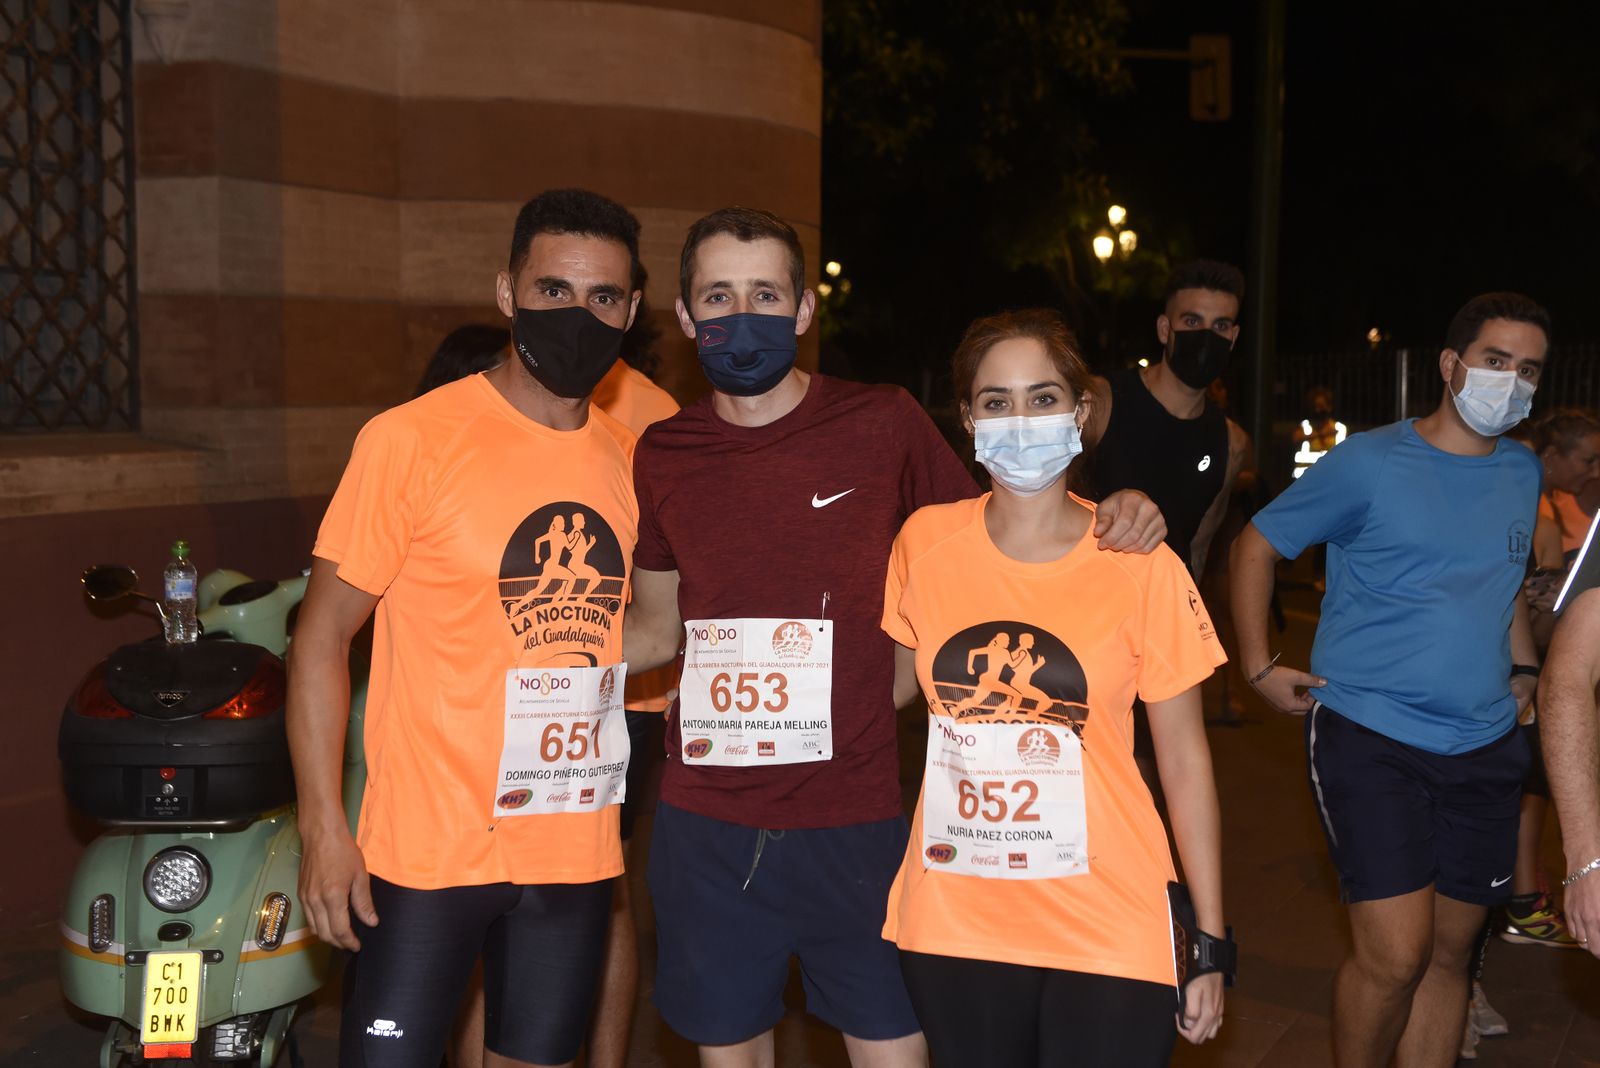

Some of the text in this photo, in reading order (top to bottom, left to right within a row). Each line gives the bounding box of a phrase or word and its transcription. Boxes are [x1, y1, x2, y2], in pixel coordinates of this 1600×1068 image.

[511, 616, 532, 636] LA
[523, 625, 605, 650] del Guadalquivir
[709, 672, 789, 713] 653
[526, 711, 551, 719] CARRERA
[682, 719, 828, 730] ANTONIO MARIA PAREJA MELLING
[540, 718, 601, 763] 651
[505, 769, 551, 781] DOMINGO
[588, 761, 625, 777] GUTIERREZ
[958, 778, 1041, 823] 652
[947, 824, 975, 839] NURIA
[976, 828, 1003, 842] PAEZ
[1005, 829, 1054, 842] CORONA
[162, 962, 183, 981] C1
[153, 986, 188, 1006] 700
